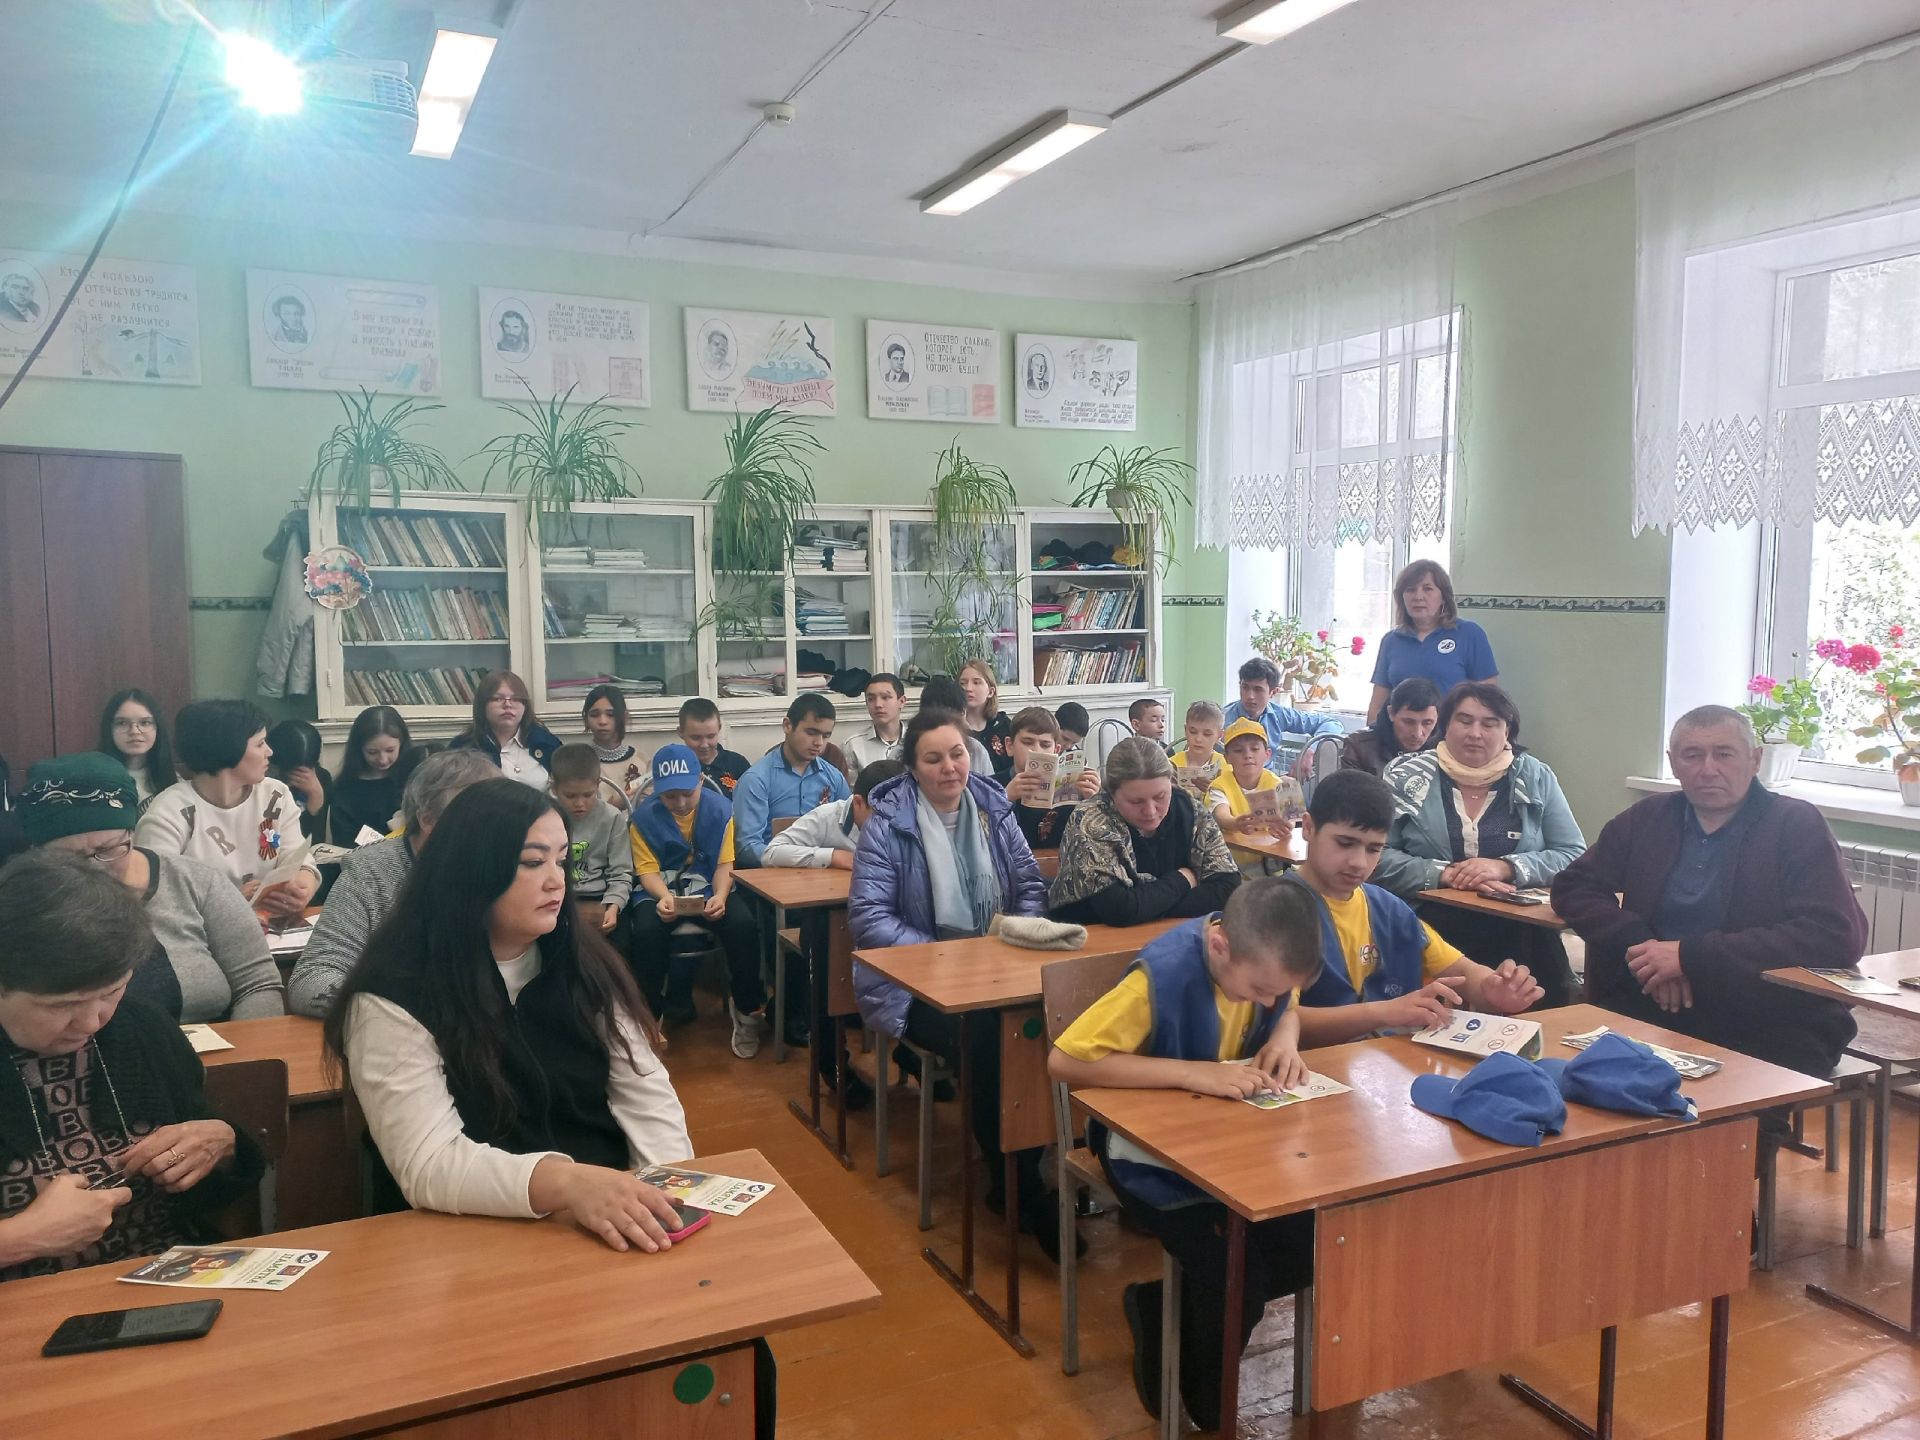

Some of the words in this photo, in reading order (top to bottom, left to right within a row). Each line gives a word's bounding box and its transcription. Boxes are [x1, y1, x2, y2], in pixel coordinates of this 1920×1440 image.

[103, 271, 154, 285] ПОЛЬЗОЮ
[84, 284, 141, 297] ОТЕЧЕСТВУ
[100, 300, 121, 309] НИМ
[131, 303, 160, 313] ЛЕГКО
[90, 313, 104, 322] НЕ
[111, 314, 171, 328] РАЗЛУЧИТСЯ
[924, 332, 959, 345] ОТЕЧЕСТВО
[925, 343, 953, 354] КОТОРОЕ
[926, 363, 952, 373] КОТОРОЕ
[659, 760, 690, 777] ЮИД
[263, 789, 283, 820] L
[205, 826, 236, 857] R
